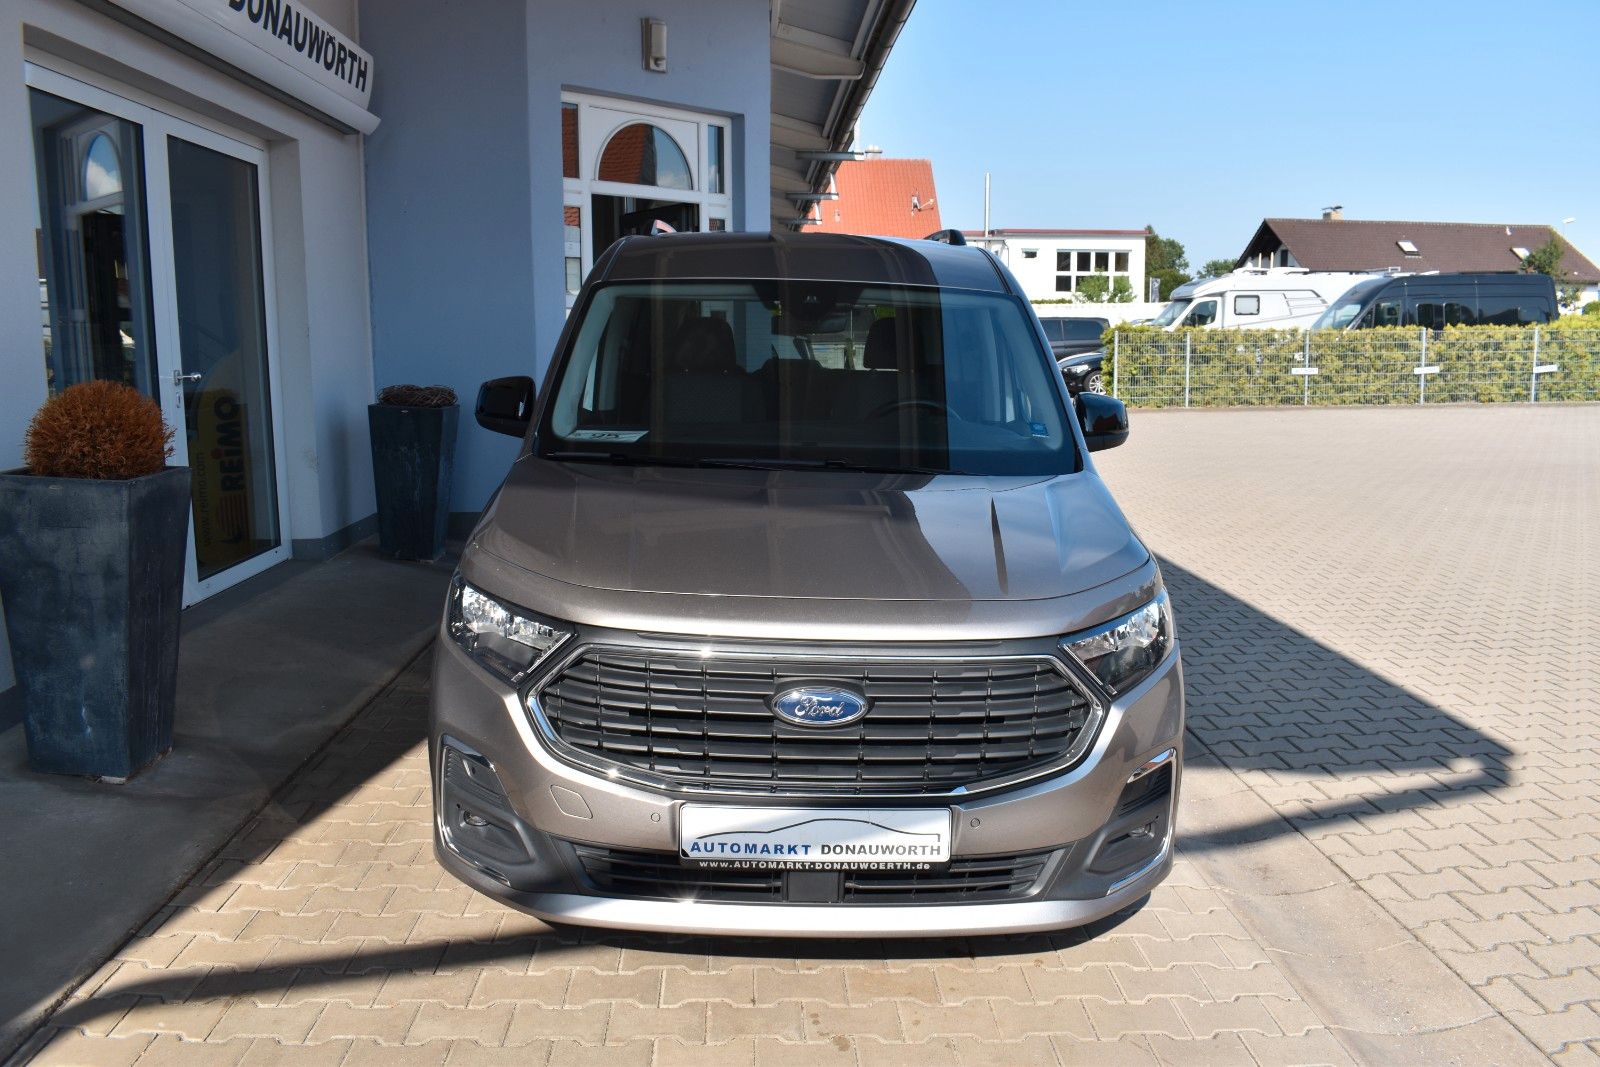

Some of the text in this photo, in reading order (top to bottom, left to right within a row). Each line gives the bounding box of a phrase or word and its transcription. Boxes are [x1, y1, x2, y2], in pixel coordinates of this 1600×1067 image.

[229, 0, 368, 92] ONAUWÖRTH
[794, 695, 844, 717] Ford
[690, 841, 812, 856] AUTOMARKT
